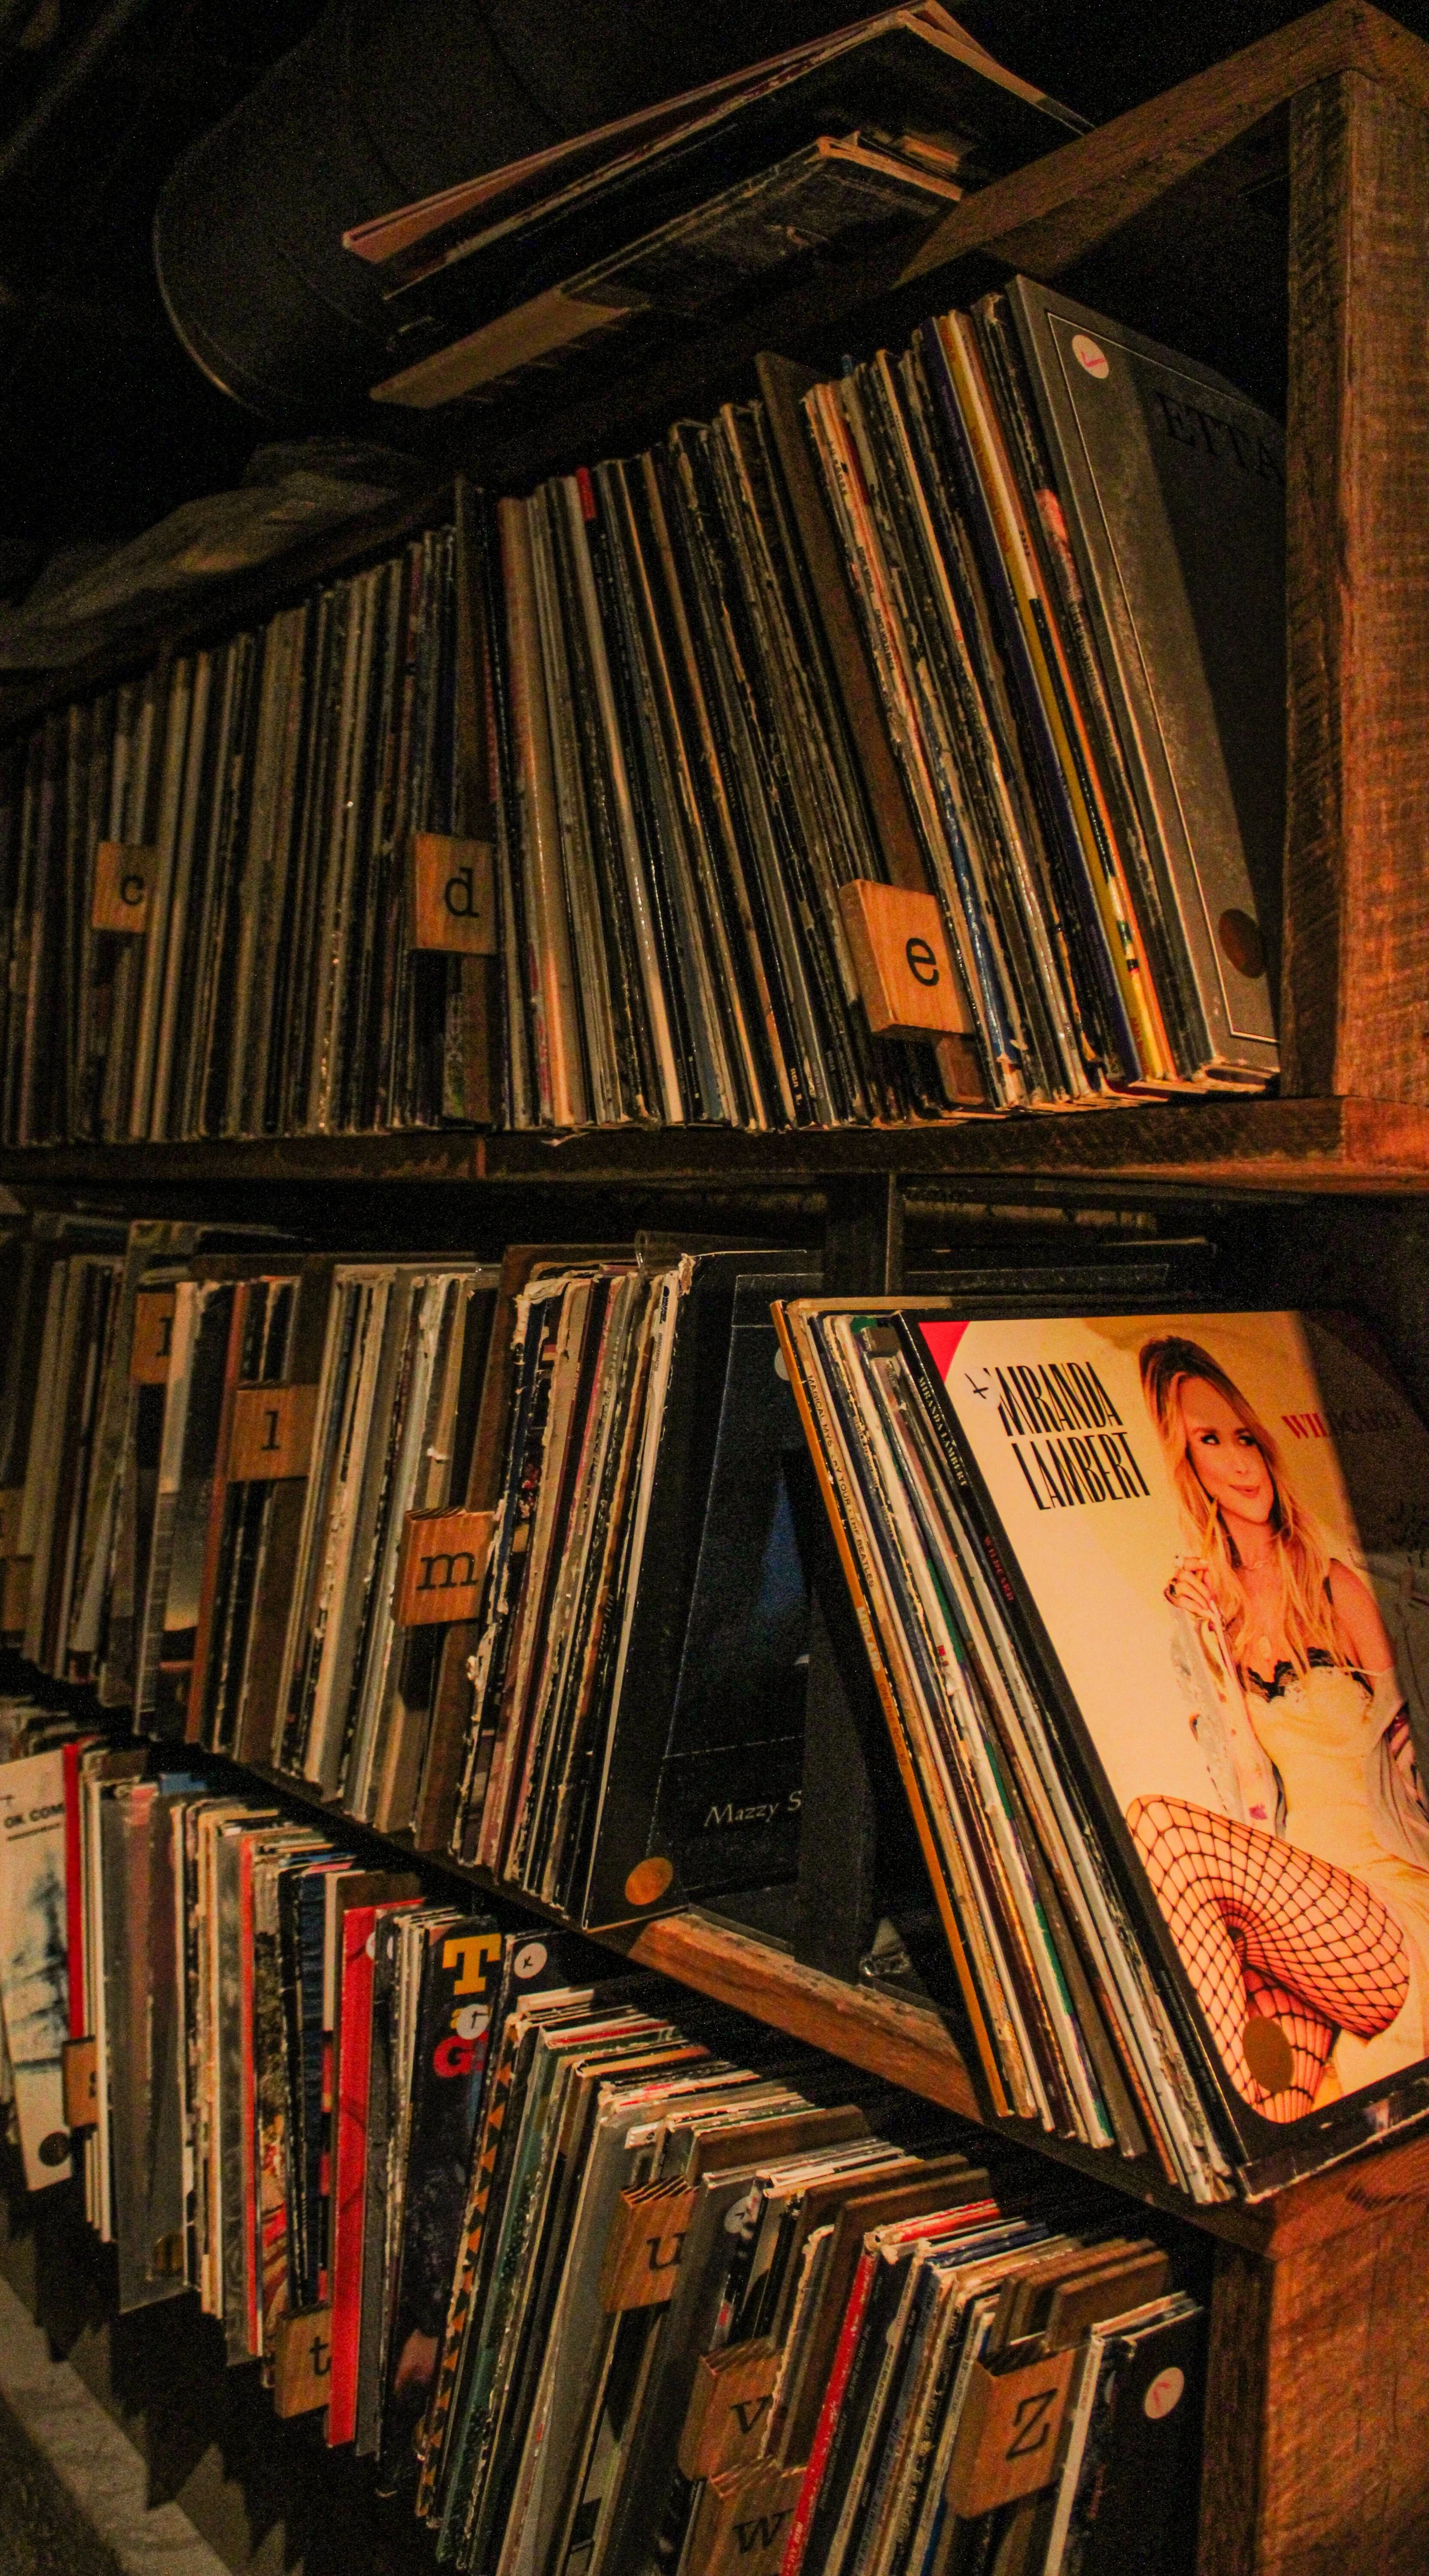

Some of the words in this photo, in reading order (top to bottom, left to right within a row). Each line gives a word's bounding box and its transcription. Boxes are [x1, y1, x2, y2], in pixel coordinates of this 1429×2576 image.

[120, 875, 145, 906] c
[445, 867, 478, 918] d
[905, 936, 939, 987] e
[983, 1361, 1123, 1437] MIRANDA
[916, 1375, 944, 1431] MIRANDA
[940, 1431, 968, 1488] LAMBERT
[807, 1374, 827, 1422] MAGICAL
[837, 1477, 852, 1507] TOUR
[855, 1538, 876, 1589] BEATLES
[1011, 1432, 1151, 1511] LAMBERT
[417, 1550, 478, 1590] m
[855, 1605, 883, 1673] MIDLAND
[890, 1726, 909, 1767] ROCKS
[703, 1802, 780, 1828] Mazzy
[442, 1933, 502, 1996] T
[646, 2232, 686, 2270] u
[309, 2336, 331, 2375] t
[733, 2513, 784, 2554] w
